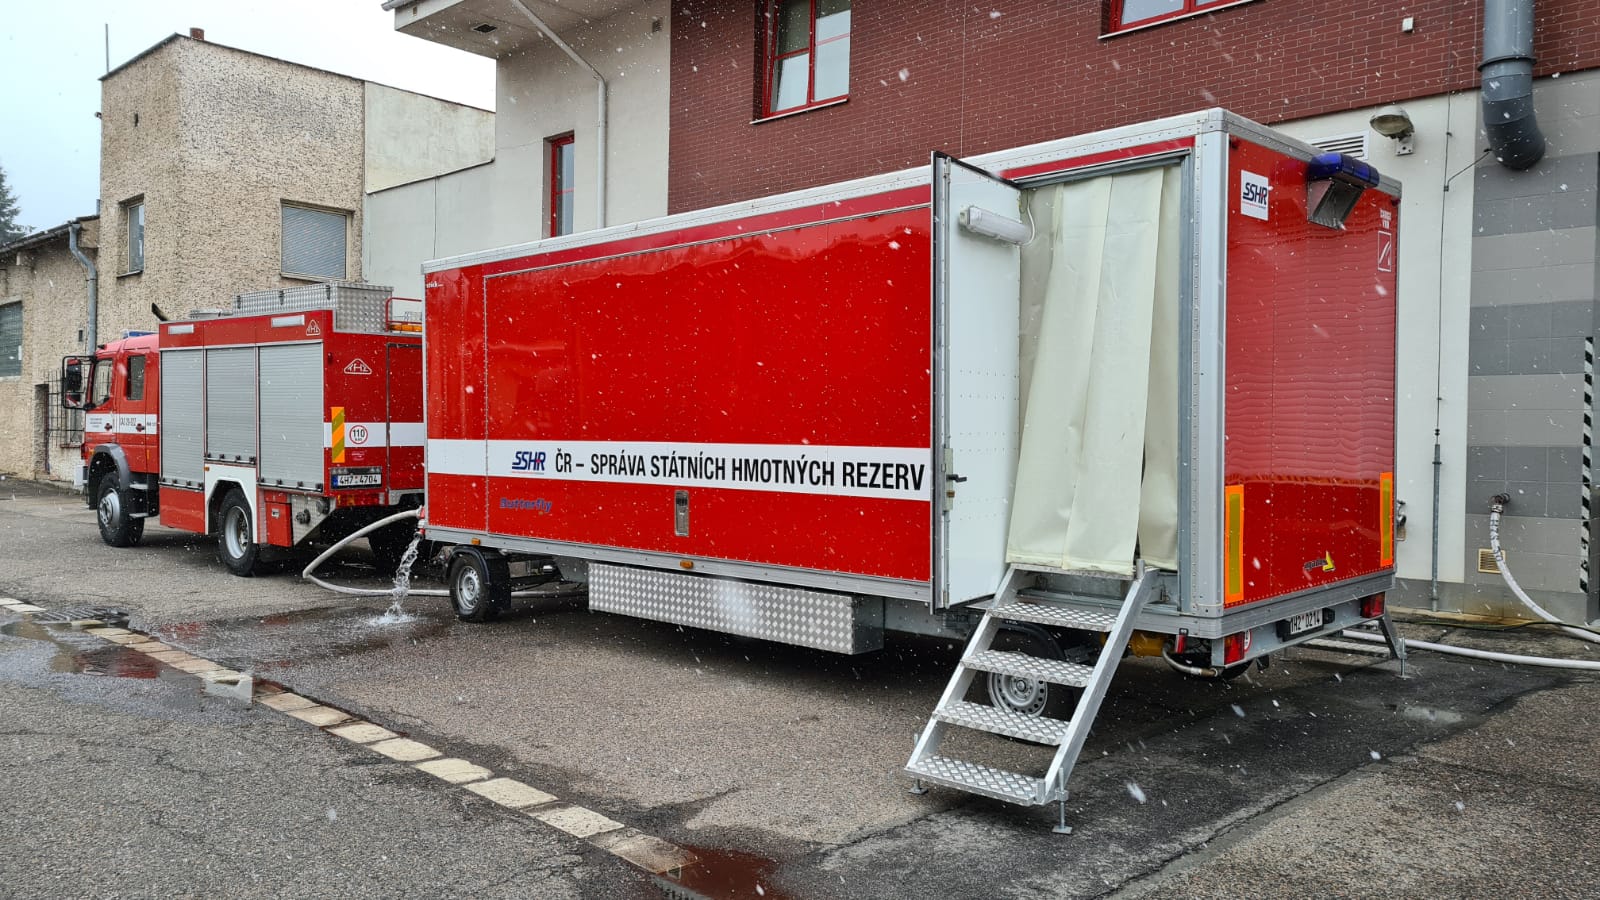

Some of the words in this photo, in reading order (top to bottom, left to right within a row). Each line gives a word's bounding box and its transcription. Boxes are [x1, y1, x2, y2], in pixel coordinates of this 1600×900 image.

[1243, 182, 1267, 205] SSHR
[352, 429, 366, 438] 110
[512, 451, 546, 471] SSHR
[555, 448, 572, 473] ČR
[590, 449, 646, 476] SPRÁVA
[650, 450, 726, 480] STÁTNÍCH
[732, 454, 834, 486] HMOTNÝCH
[842, 461, 925, 490] REZERV
[339, 475, 354, 484] 4H7
[359, 475, 378, 483] 4704
[500, 497, 552, 513] Butterfly
[1306, 610, 1320, 628] 0214
